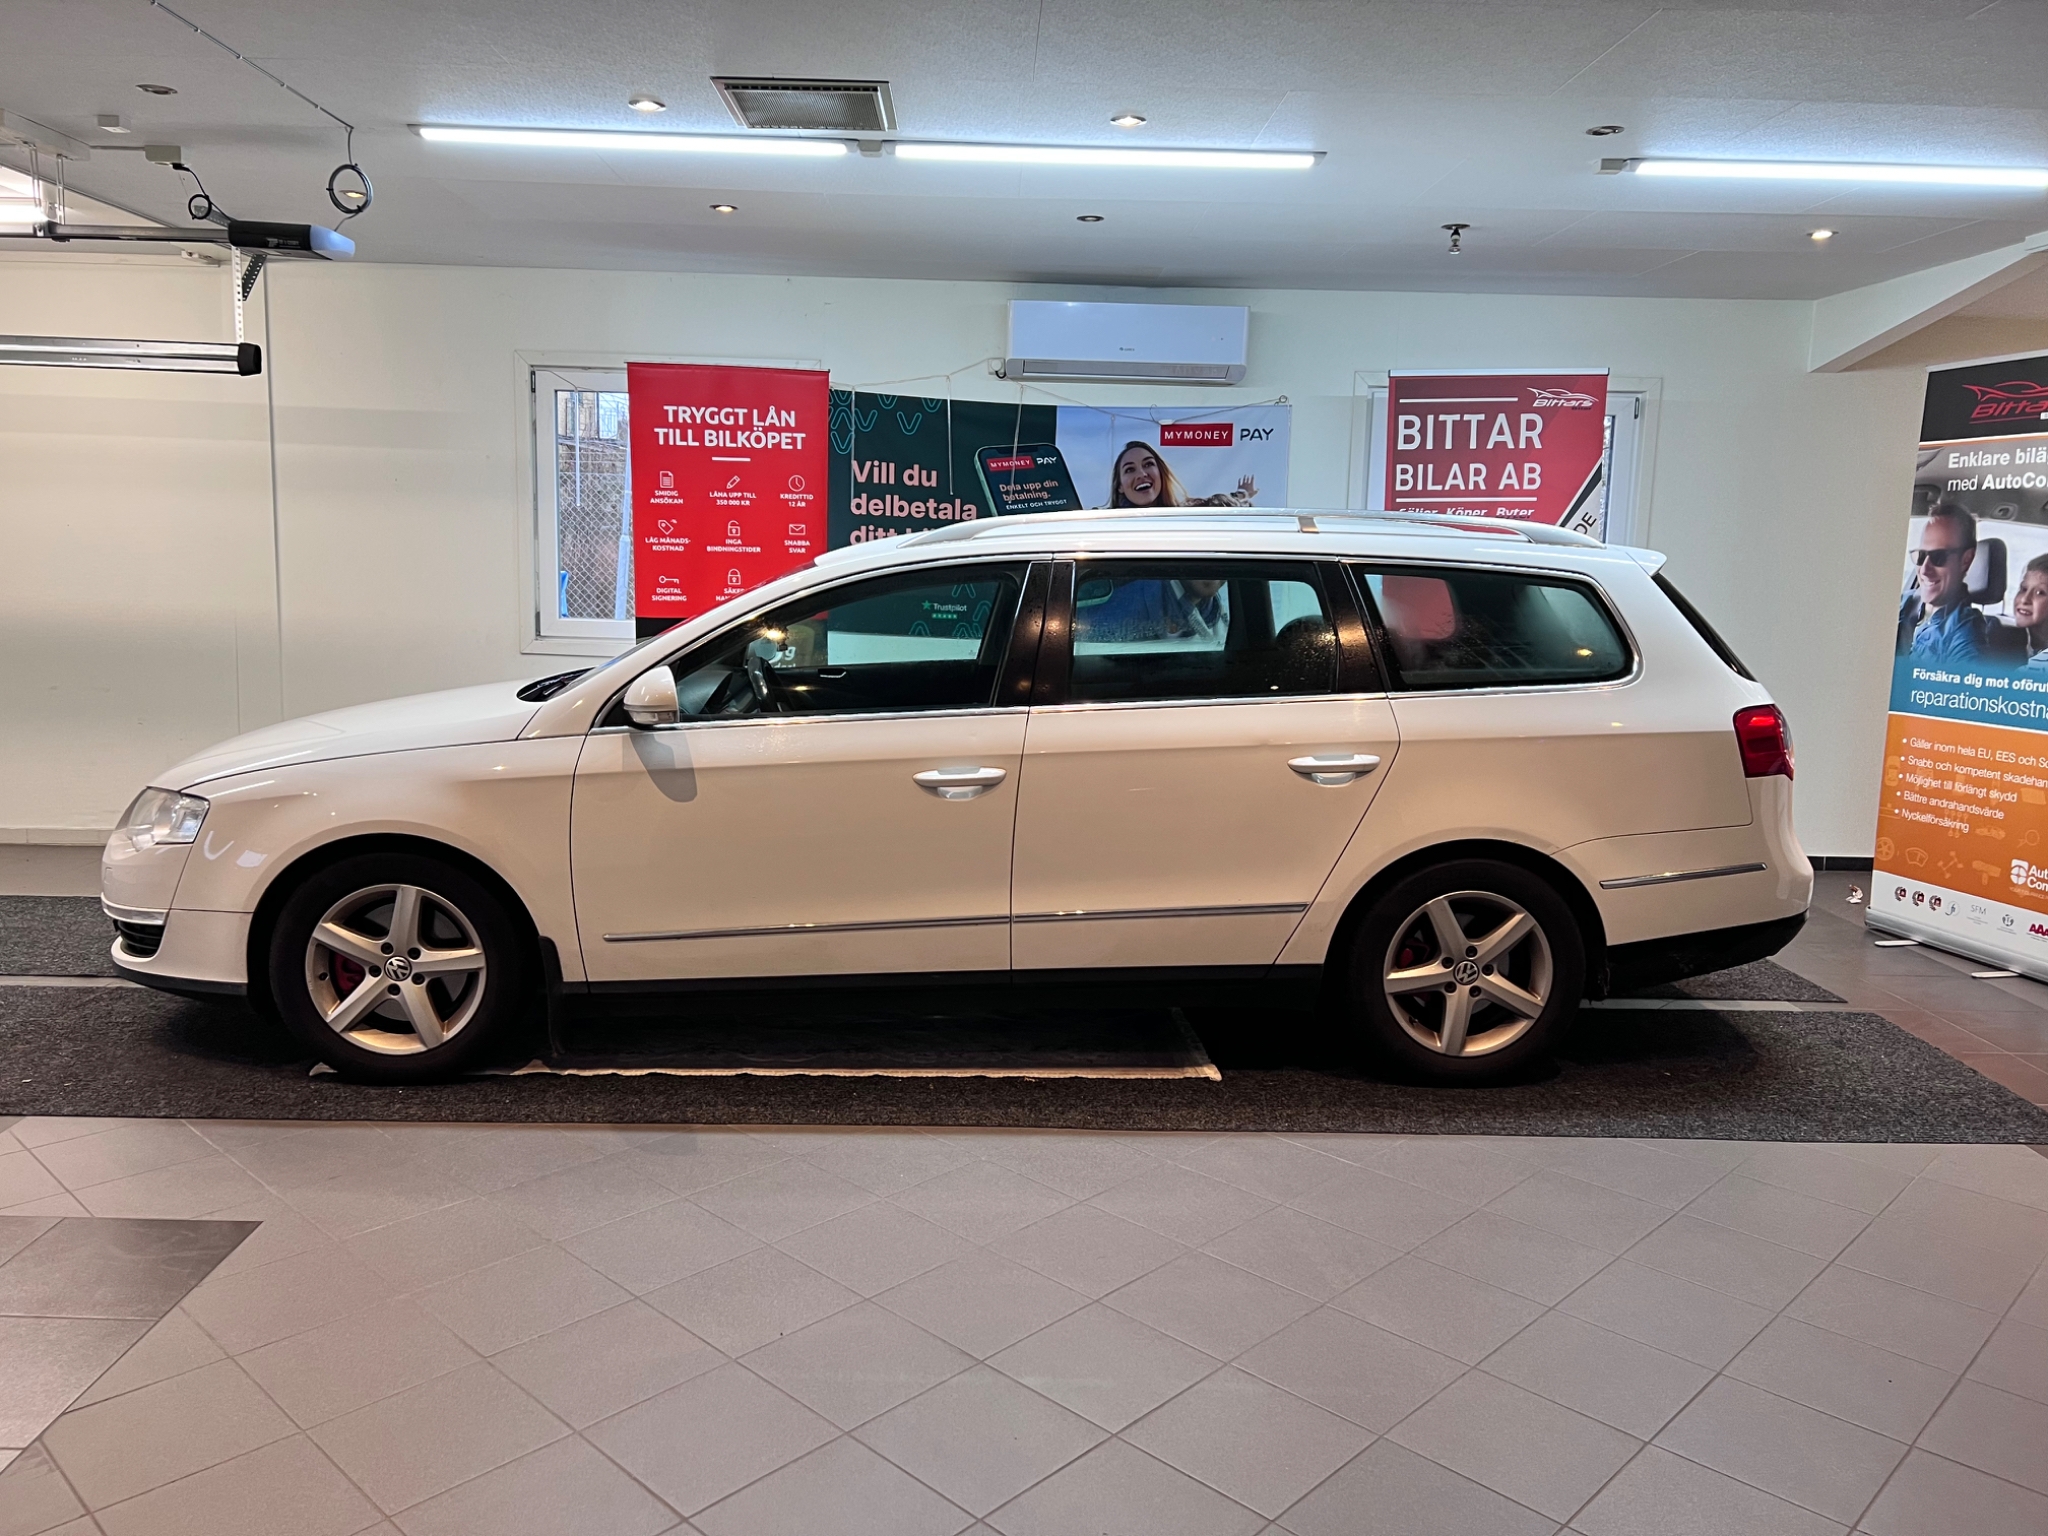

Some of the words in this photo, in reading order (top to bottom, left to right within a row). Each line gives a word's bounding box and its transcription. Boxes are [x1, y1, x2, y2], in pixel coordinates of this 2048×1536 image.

[1532, 398, 1593, 407] Bittars
[663, 405, 748, 425] TRYGGT
[753, 405, 796, 427] LÅN
[654, 428, 699, 446] TILL
[704, 426, 806, 450] BILKÖPET
[1164, 430, 1229, 440] MYMONEY
[1240, 428, 1274, 441] PAY
[1397, 413, 1543, 450] BITTAR
[990, 460, 1030, 468] MYMONEY
[1036, 456, 1057, 465] PAY
[1948, 450, 2010, 469] Enklare
[2015, 446, 2048, 465] bilä
[852, 460, 896, 485] Vill
[903, 464, 938, 488] du
[1023, 482, 1042, 490] upp
[1043, 480, 1059, 488] din
[1395, 463, 1487, 491] BILAR
[1498, 462, 1542, 490] AB
[1947, 474, 1978, 491] med
[1981, 472, 2048, 490] AutoCo
[851, 493, 977, 521] delbetala
[934, 602, 967, 612] Trustpilot
[1913, 668, 1961, 684] Försäkra
[1964, 674, 1982, 688] dig
[1986, 677, 2010, 689] mot
[1911, 690, 2048, 719] reparationskostn
[1910, 737, 1933, 750] Gäller
[1934, 741, 1956, 754] inom
[1958, 745, 1976, 757] hela
[1978, 748, 1993, 761] EU,
[1996, 750, 2016, 763] EES
[2018, 756, 2036, 766] och
[1908, 755, 1934, 769] Snabb
[1936, 762, 1952, 772] och
[1954, 763, 2001, 780] kompetent
[1906, 773, 1941, 788] Möjlighet
[1944, 780, 1954, 790] till
[1955, 782, 1987, 799] förlängt
[1989, 789, 2018, 803] skydd
[1904, 790, 1927, 804] Bättre
[1929, 796, 2005, 820] andrahandsvärde
[1901, 808, 1970, 833] Nyckelförsäkring
[1970, 904, 1987, 916] SFM
